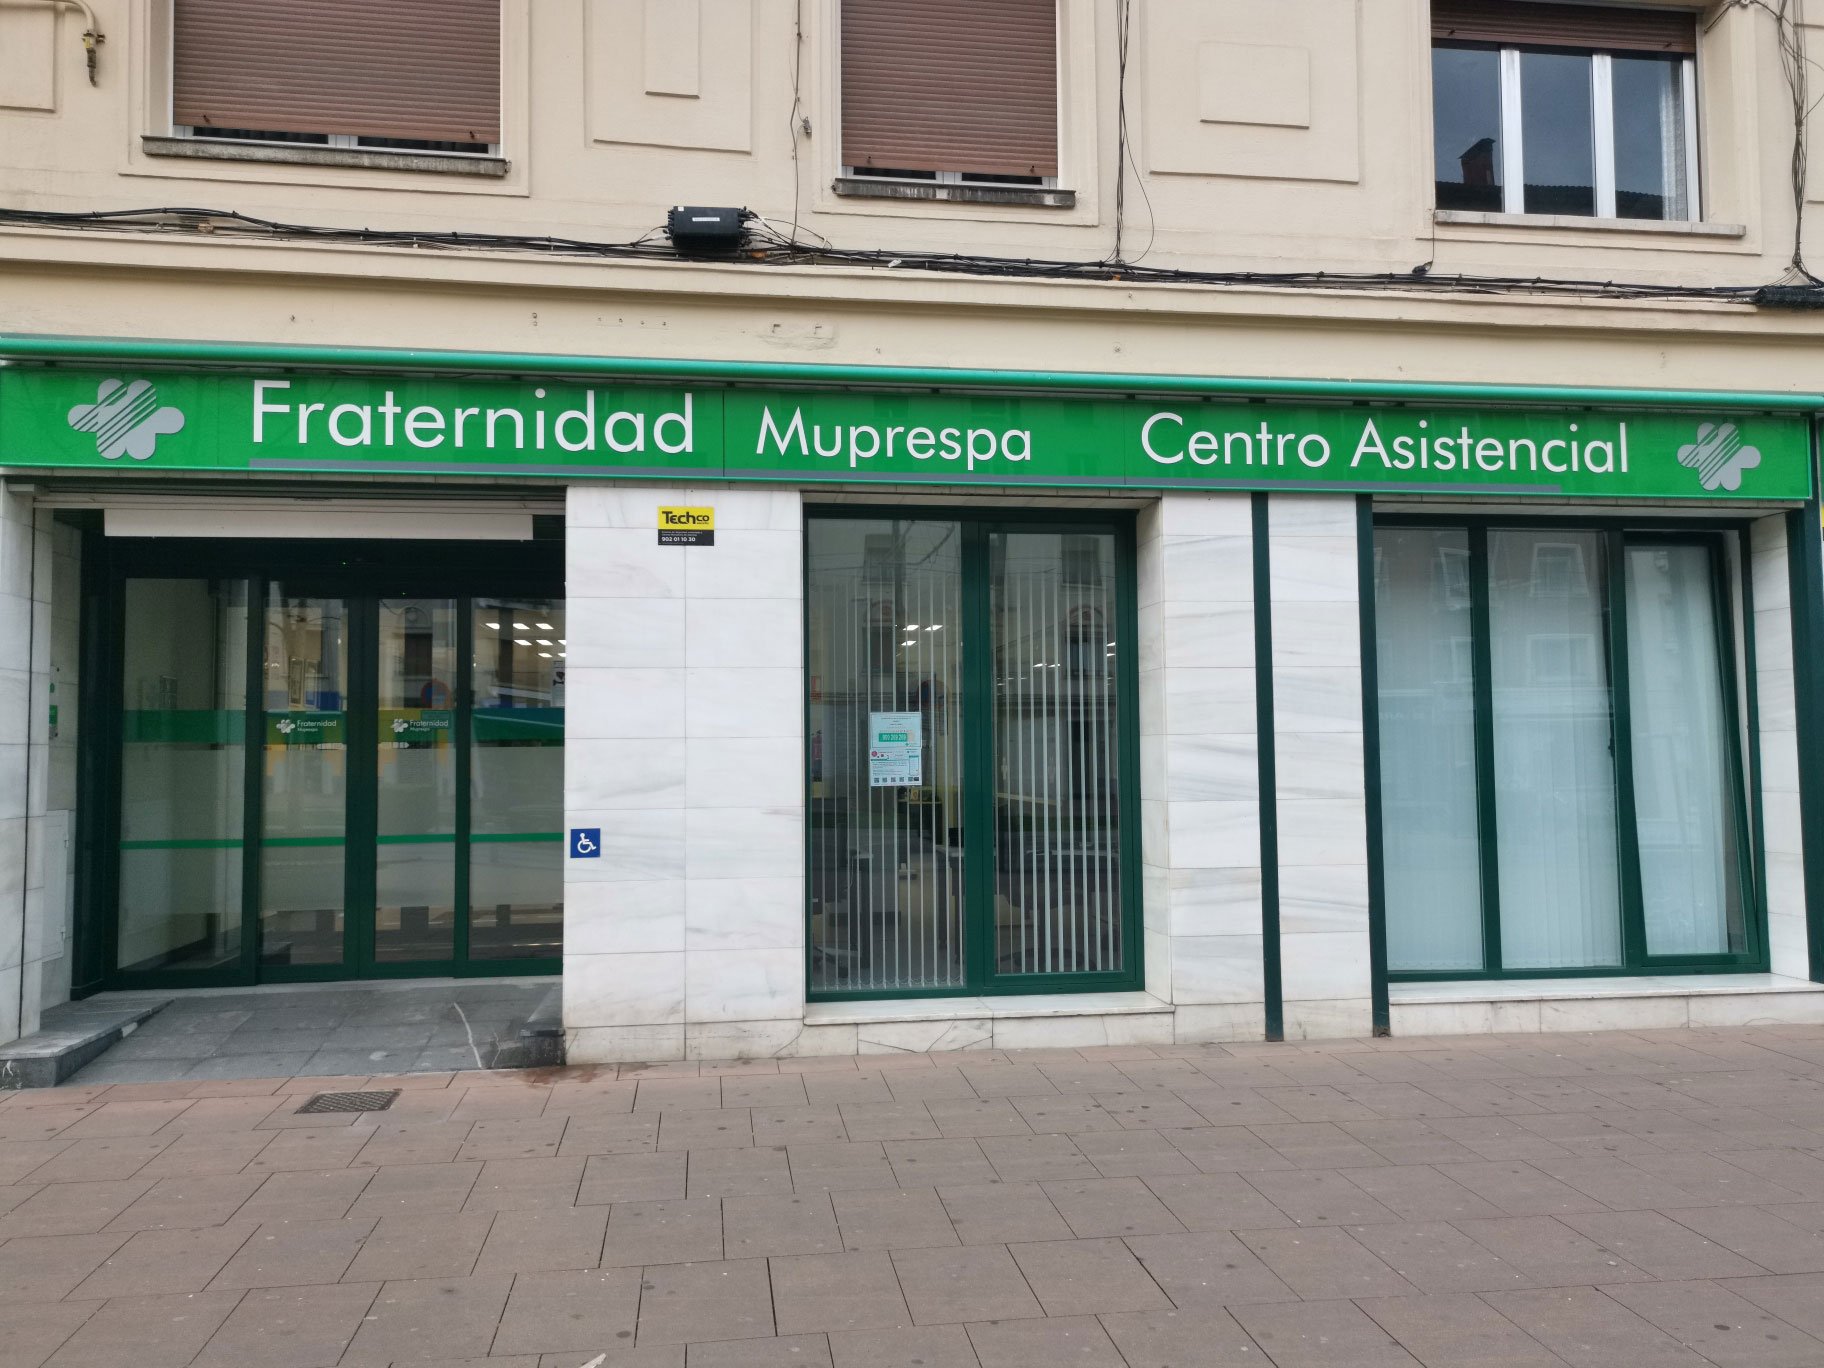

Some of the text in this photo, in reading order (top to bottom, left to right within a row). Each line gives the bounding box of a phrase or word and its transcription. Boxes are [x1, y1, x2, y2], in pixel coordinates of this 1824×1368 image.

[252, 378, 1630, 474] Fraternidad Muprespa Centro Asistencial
[662, 511, 710, 524] Techco
[410, 719, 449, 727] Fraternidad
